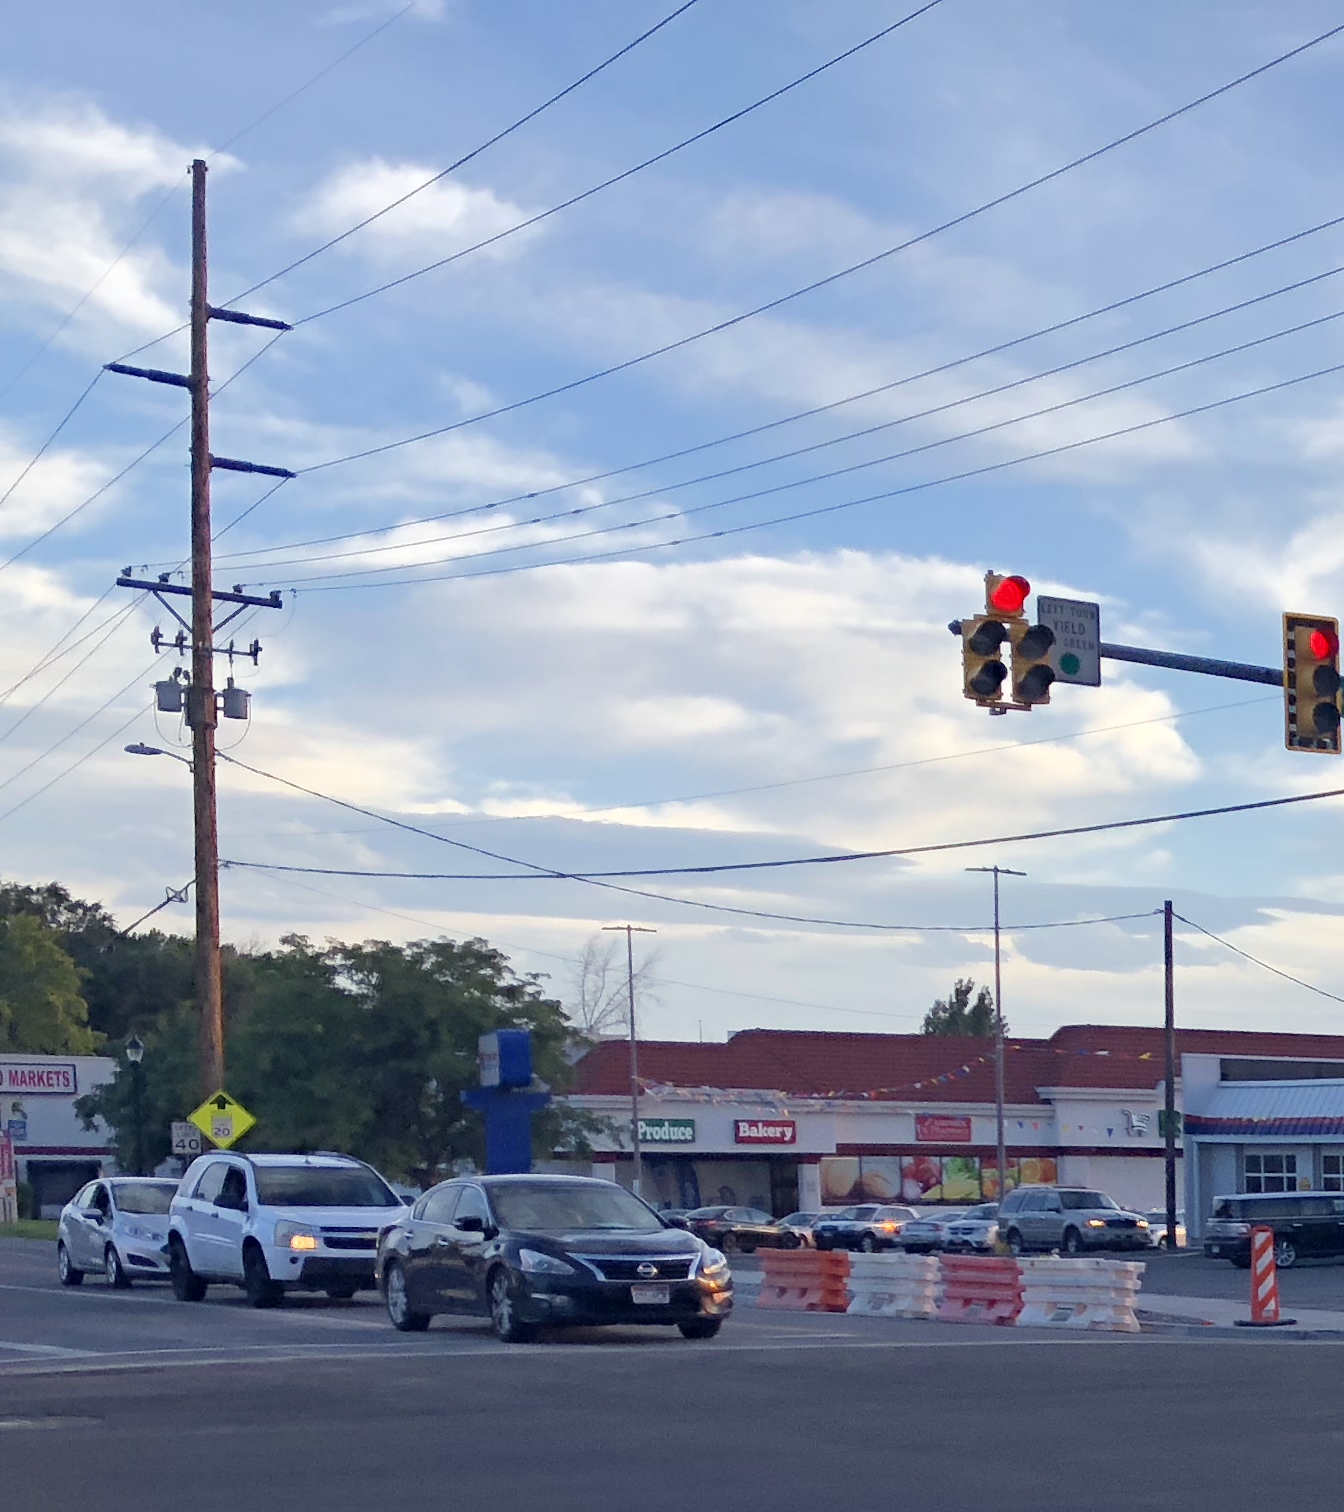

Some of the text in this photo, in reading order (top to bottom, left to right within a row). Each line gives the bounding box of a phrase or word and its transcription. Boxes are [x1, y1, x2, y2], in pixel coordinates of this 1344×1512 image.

[1041, 602, 1064, 615] LEFT
[1053, 619, 1086, 636] YIELD
[8, 1069, 71, 1088] MARKETS
[214, 1127, 231, 1137] 20
[637, 1121, 693, 1140] Produce
[738, 1122, 793, 1141] Bakery
[175, 1139, 200, 1151] 40
